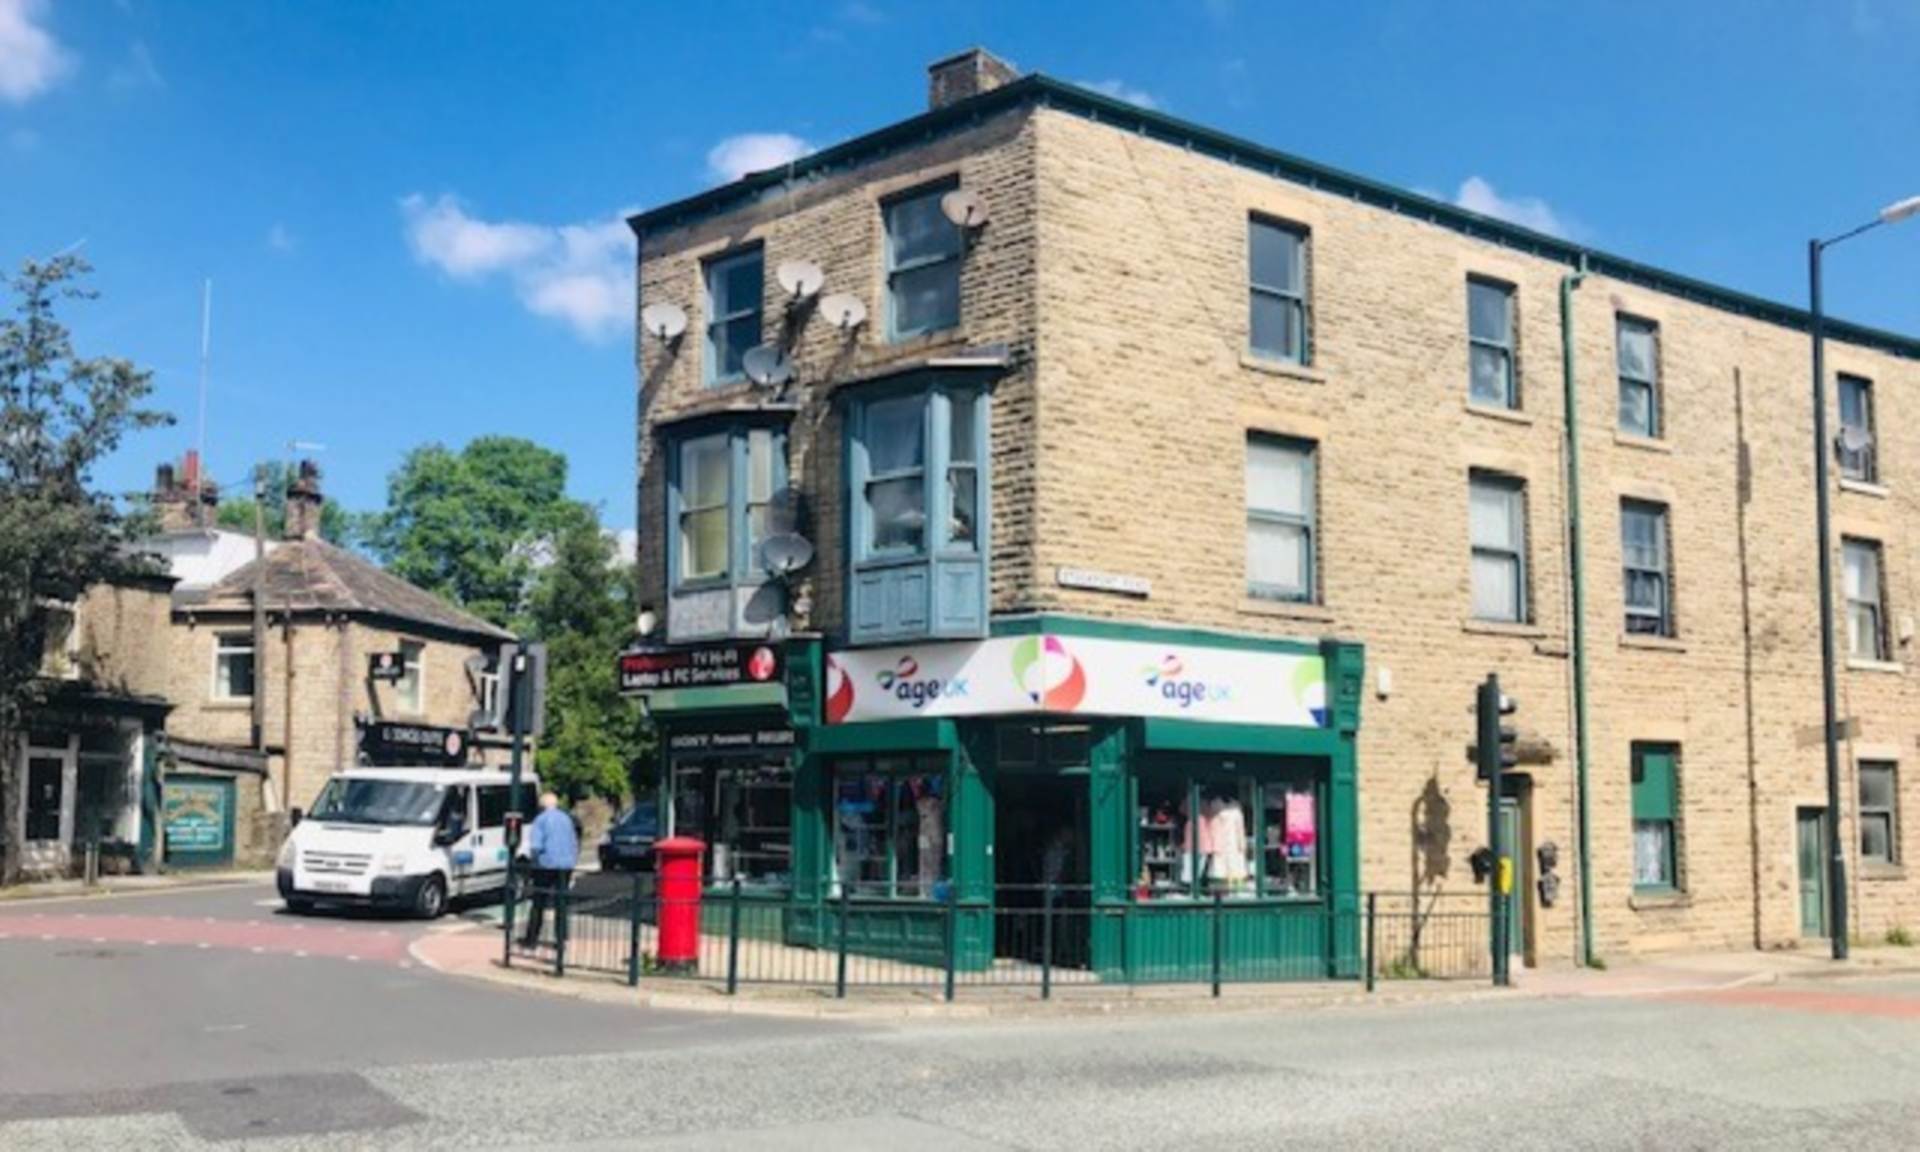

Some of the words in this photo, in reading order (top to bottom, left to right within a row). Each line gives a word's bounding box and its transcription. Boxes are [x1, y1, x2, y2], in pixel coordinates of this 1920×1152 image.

[692, 652, 707, 665] TV
[661, 669, 671, 683] &
[673, 668, 690, 684] PC
[896, 680, 939, 707] age
[1162, 681, 1206, 708] age
